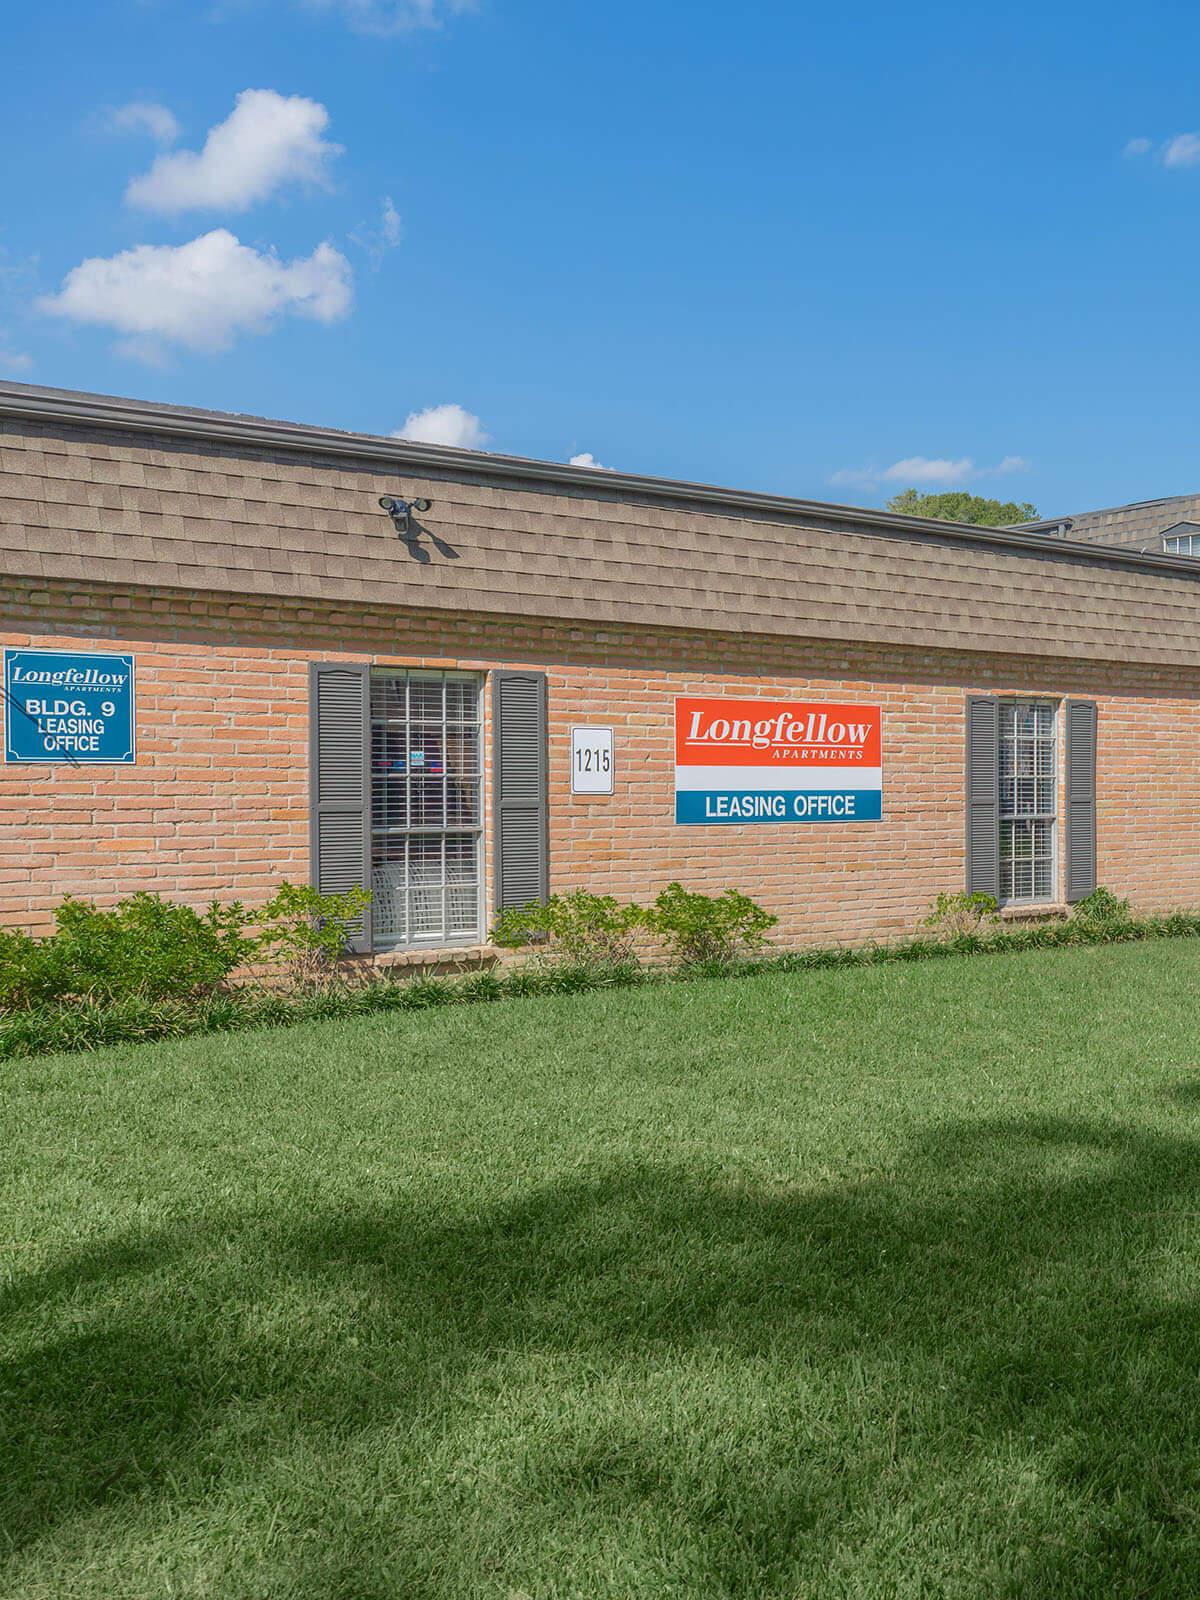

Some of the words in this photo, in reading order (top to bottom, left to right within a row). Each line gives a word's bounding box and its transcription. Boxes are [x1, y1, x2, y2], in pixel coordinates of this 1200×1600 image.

[12, 666, 128, 686] Longfellow
[25, 699, 92, 716] BLDG.
[101, 701, 116, 717] 9
[38, 718, 105, 734] LEASING
[686, 711, 873, 750] Longfellow
[43, 735, 100, 751] OFFICE
[576, 748, 610, 772] 1215
[772, 749, 864, 760] APARTMENTS
[705, 796, 786, 817] LEASING
[793, 795, 856, 816] OFFICE
